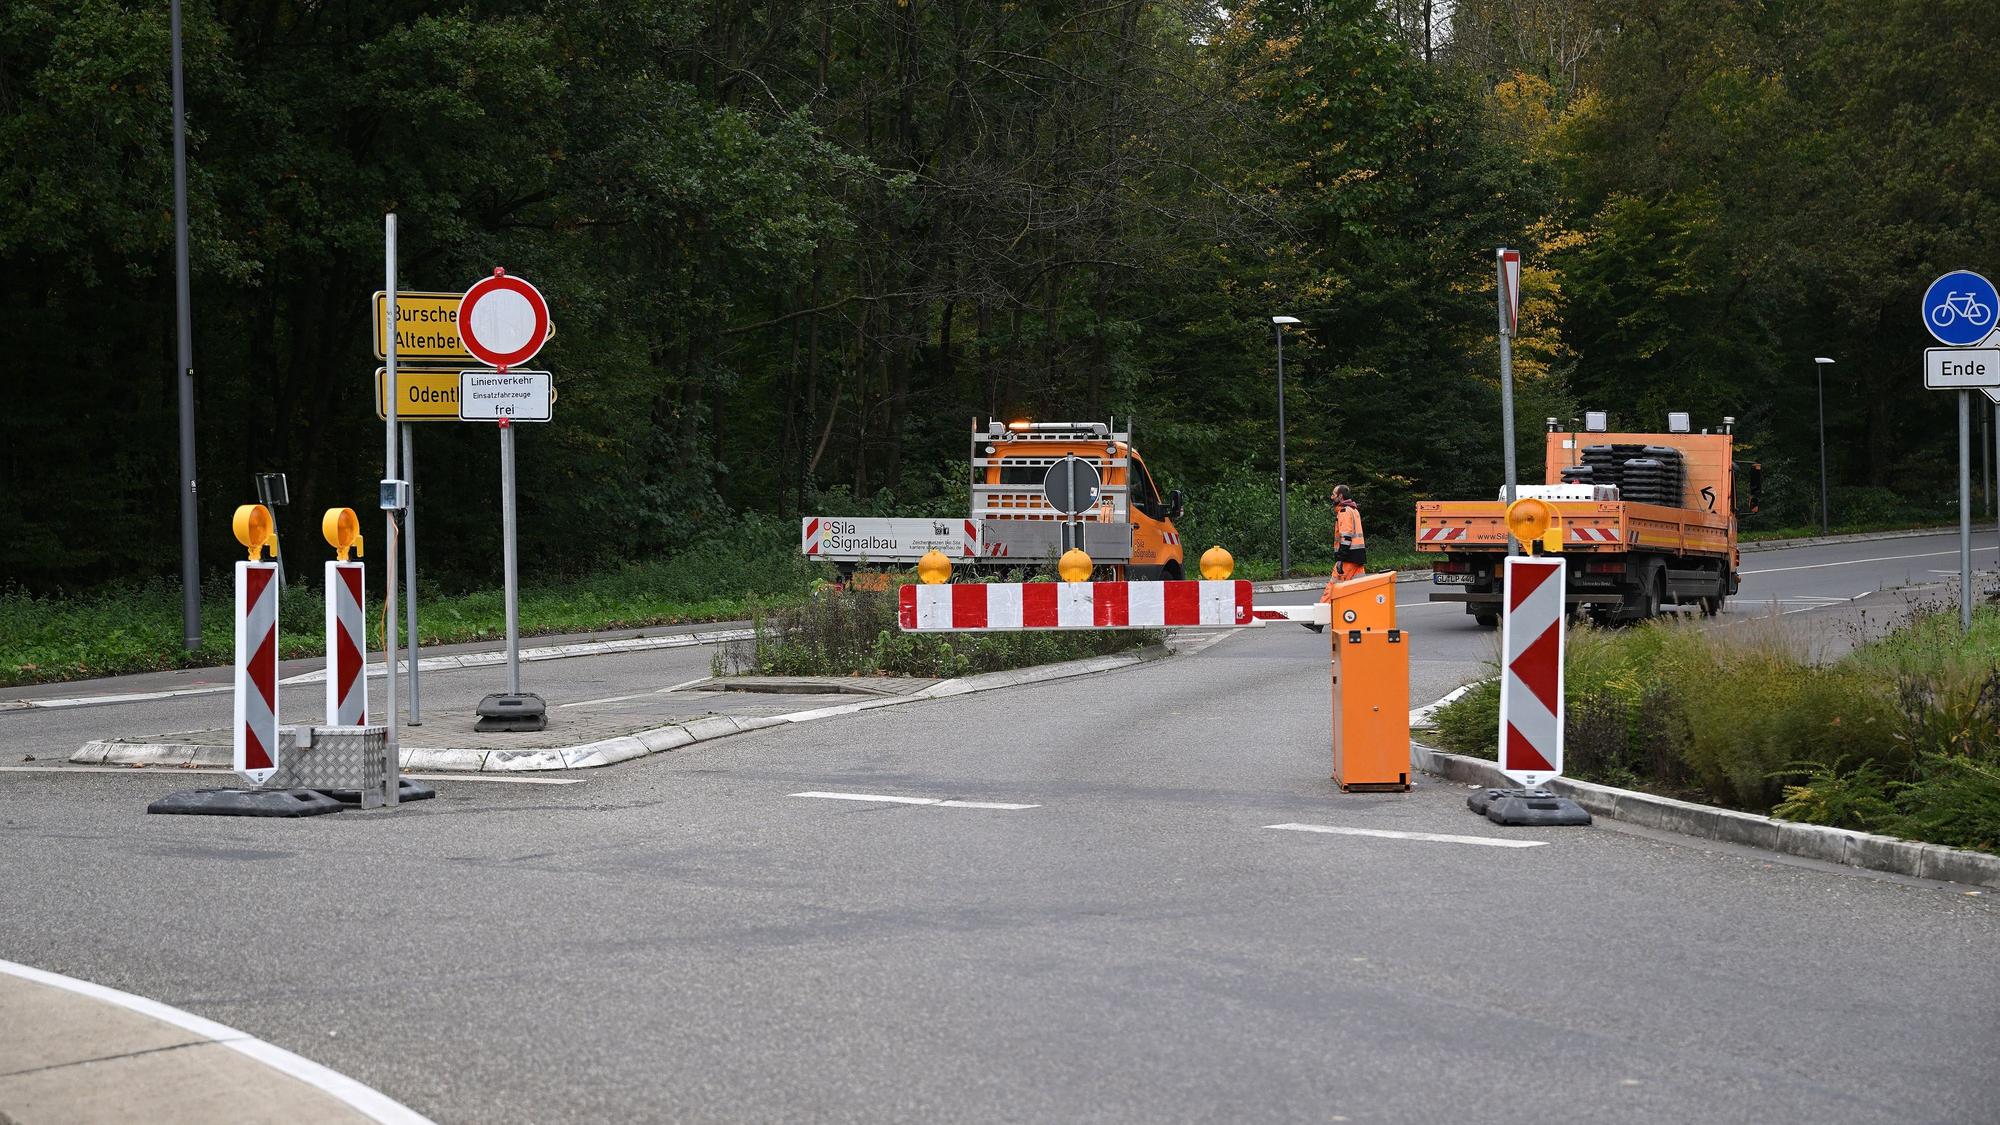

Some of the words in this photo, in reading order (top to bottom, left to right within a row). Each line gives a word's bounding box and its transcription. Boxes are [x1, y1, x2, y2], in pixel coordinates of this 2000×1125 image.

[396, 332, 469, 353] Altenber
[1942, 361, 1985, 376] Ende
[471, 376, 533, 386] Linienverkehr
[473, 391, 531, 399] Einsatzfahrzeuge
[495, 404, 515, 415] frei
[831, 521, 856, 535] Sila
[831, 535, 897, 552] Signalbau
